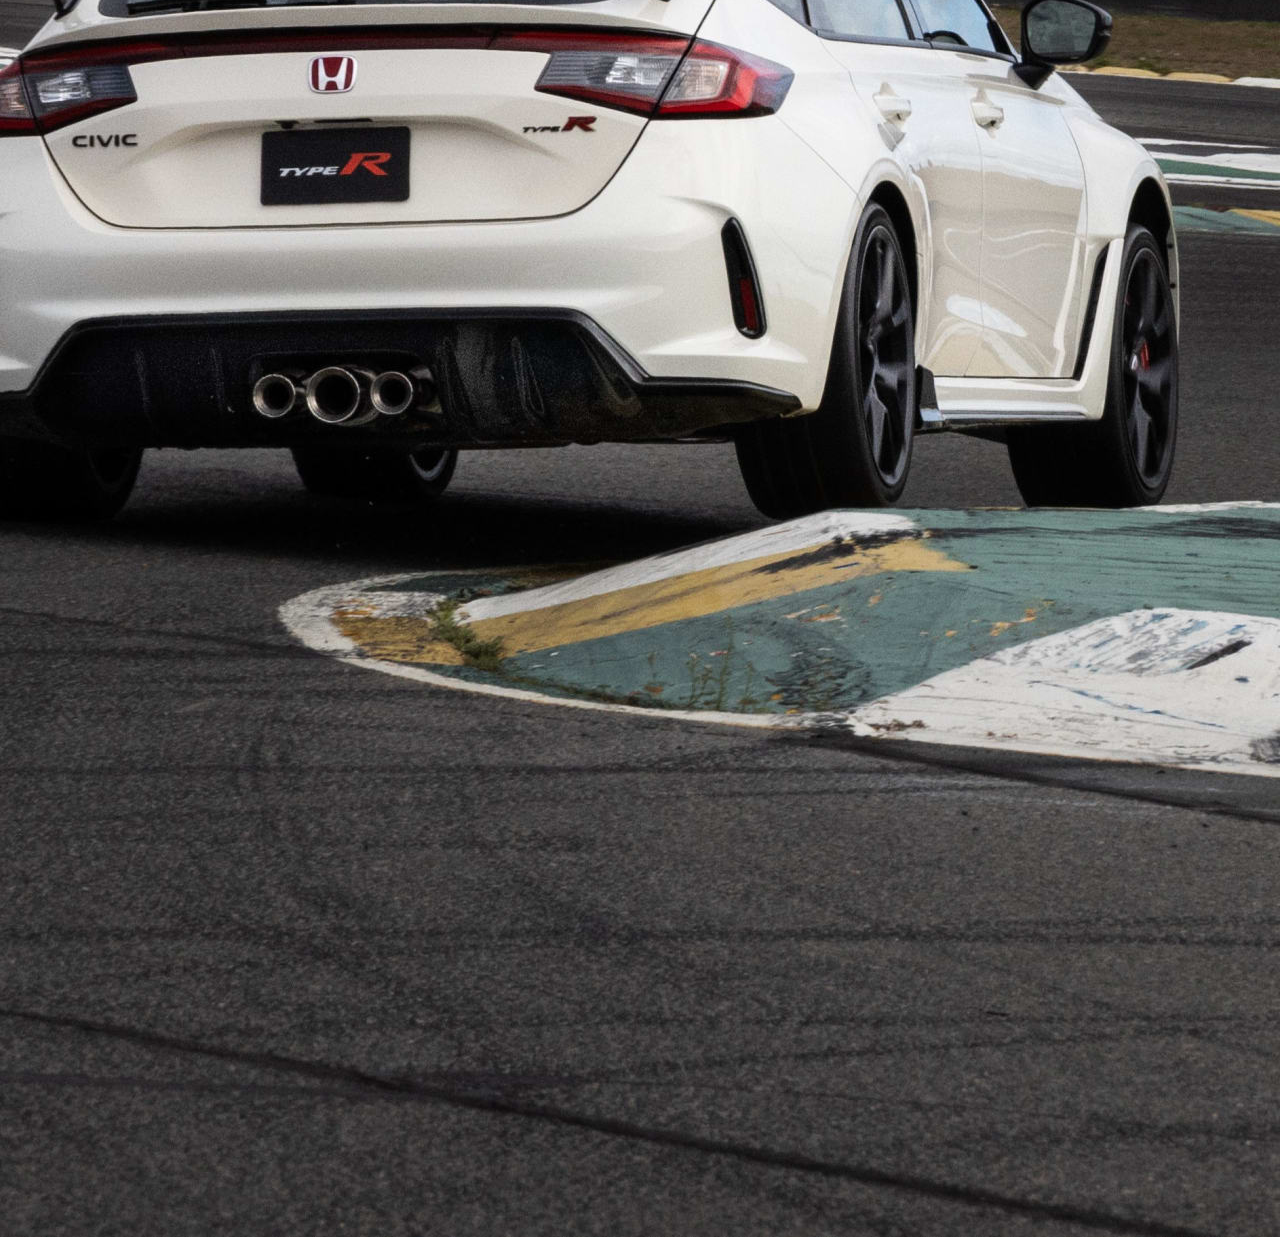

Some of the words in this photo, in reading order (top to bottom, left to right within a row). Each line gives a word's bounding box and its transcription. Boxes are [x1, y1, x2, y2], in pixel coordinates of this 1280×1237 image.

[561, 116, 597, 132] R
[72, 134, 138, 147] CIVIC
[279, 166, 340, 177] TYPE
[340, 152, 391, 176] R
